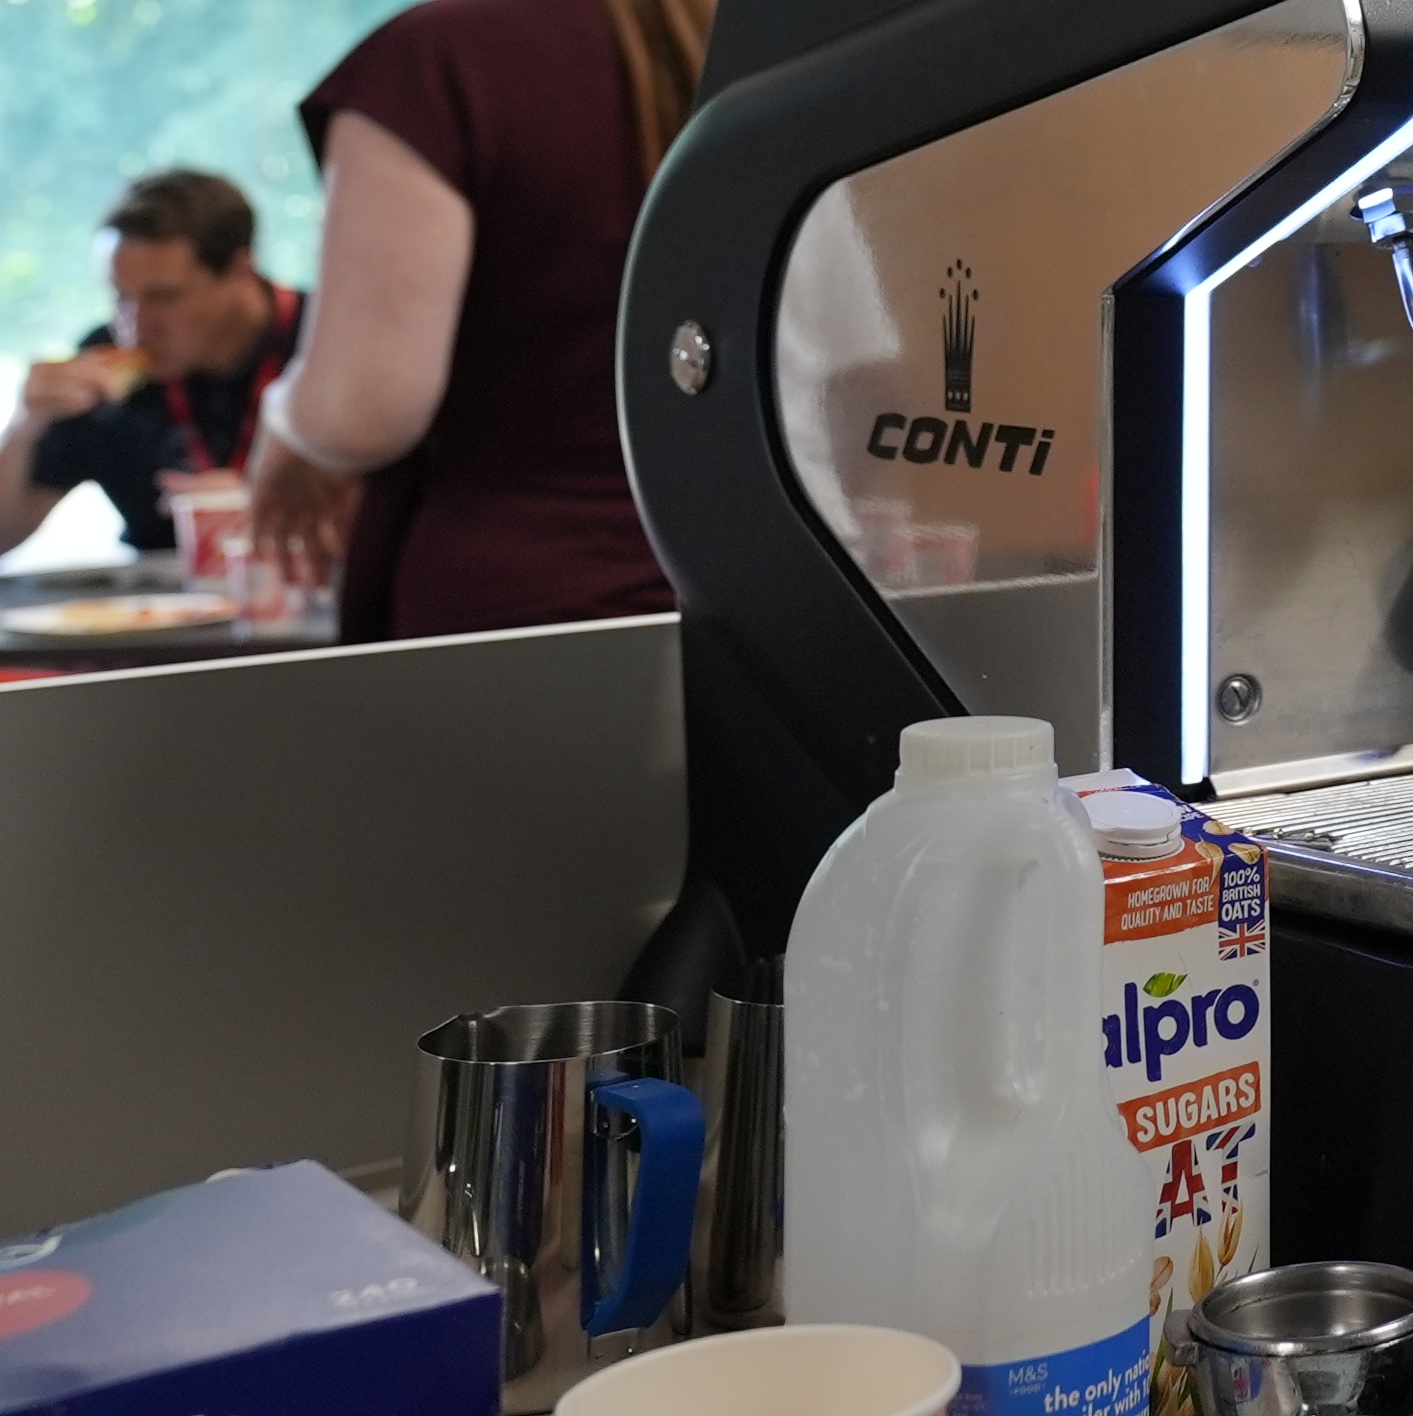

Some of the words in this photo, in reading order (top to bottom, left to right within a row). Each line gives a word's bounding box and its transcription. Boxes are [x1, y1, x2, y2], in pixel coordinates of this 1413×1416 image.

[1128, 882, 1189, 909] HOMEGROWN
[1192, 877, 1210, 894] FOR
[1222, 884, 1261, 902] BRITISH
[1223, 866, 1260, 888] 100%
[1121, 905, 1161, 930] QUALITY
[1162, 902, 1183, 922] AND
[1186, 895, 1214, 917] TASTE
[1221, 898, 1261, 922] OATS
[1136, 1072, 1256, 1143] SUGARS
[1154, 1121, 1256, 1240] AT
[1008, 1362, 1048, 1385] M&S
[1044, 1385, 1080, 1414] the
[1085, 1368, 1122, 1401] only
[1114, 1381, 1141, 1415] with
